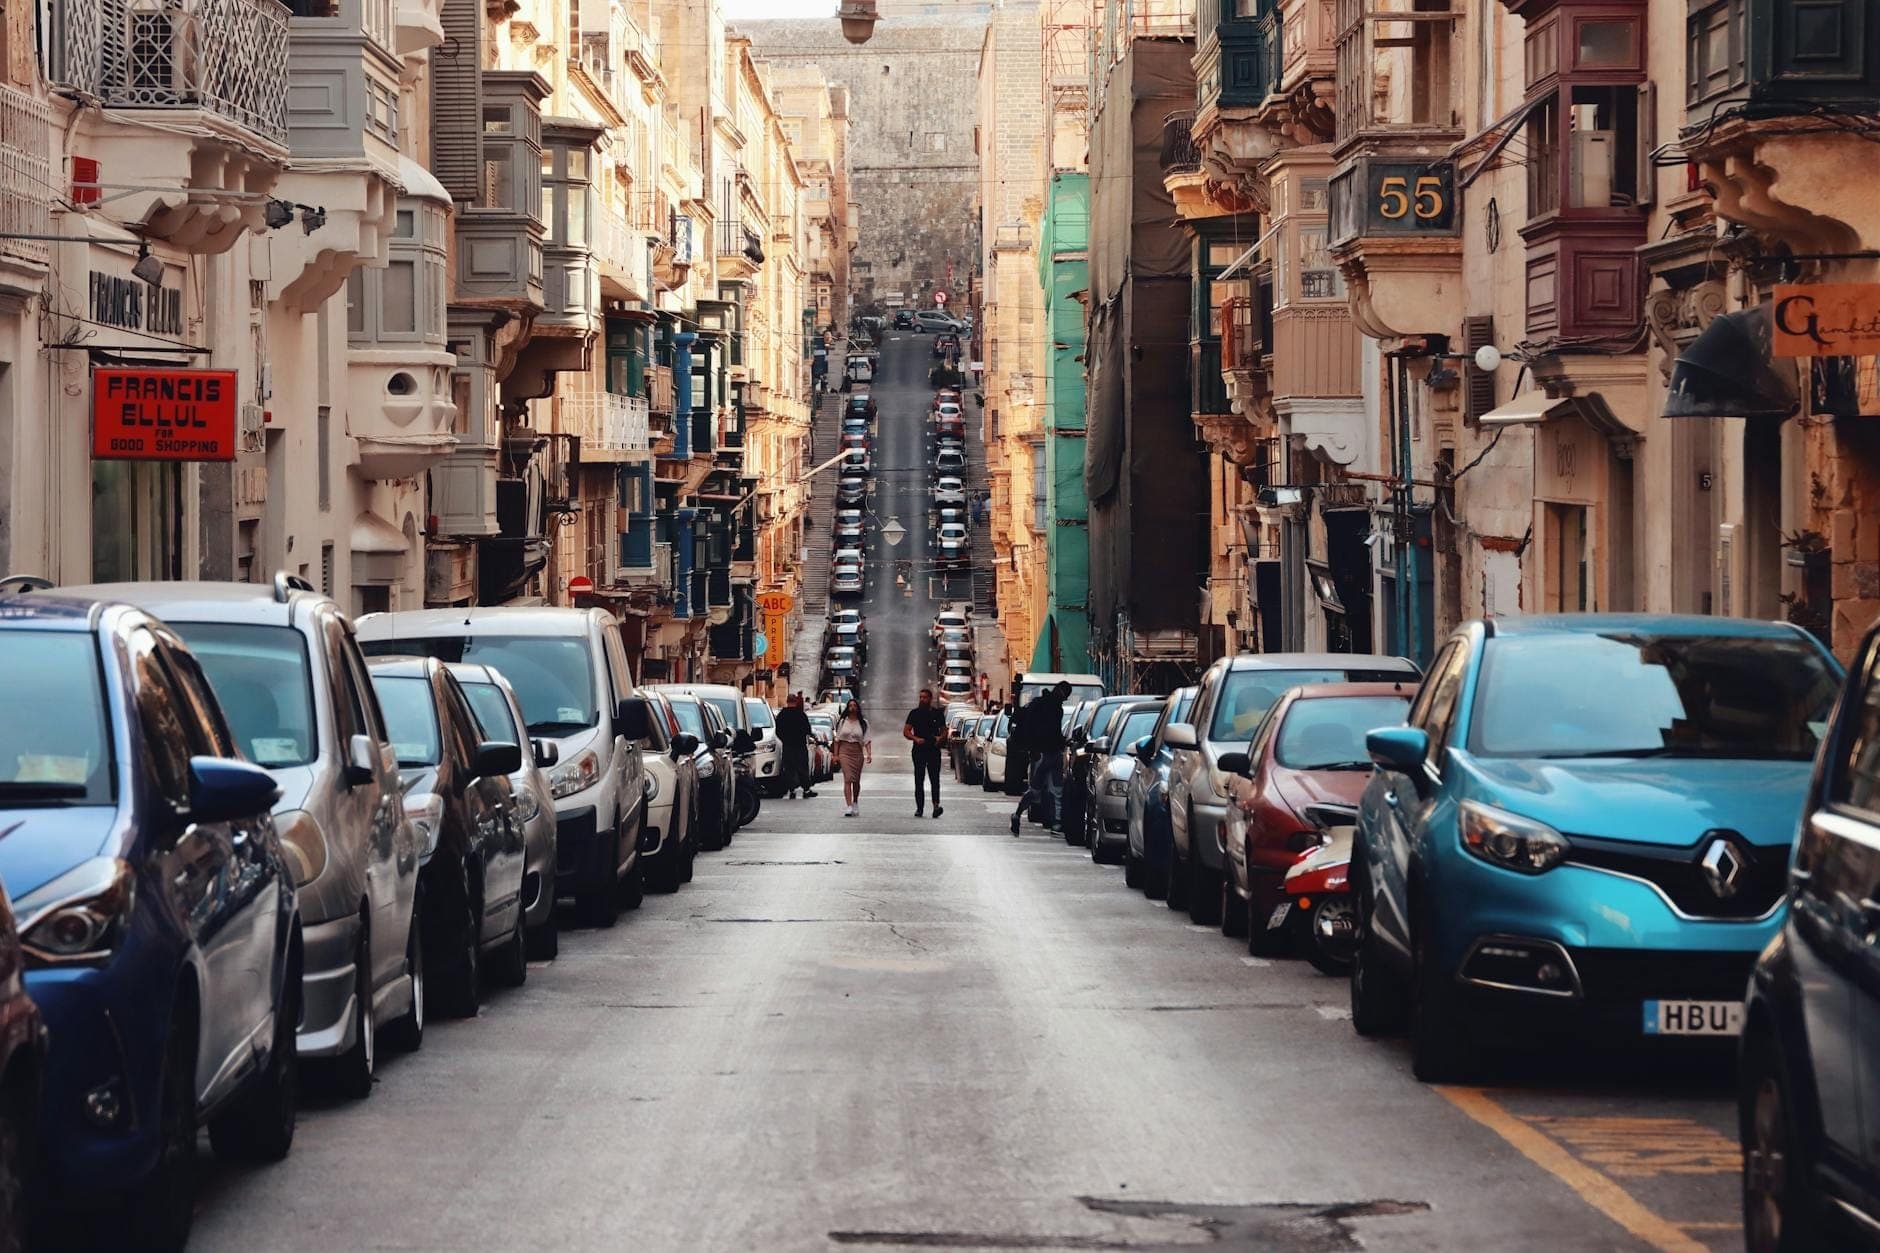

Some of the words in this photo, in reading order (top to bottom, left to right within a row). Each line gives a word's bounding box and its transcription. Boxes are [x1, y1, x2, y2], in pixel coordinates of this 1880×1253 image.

[1381, 176, 1443, 218] 55
[90, 270, 143, 329] FRANCIS
[147, 285, 182, 335] ELLUL
[108, 377, 220, 401] FRANCIS
[122, 404, 206, 427] ELLUL
[155, 429, 174, 438] FOR
[111, 439, 144, 451] GOOD
[155, 439, 217, 452] SHOPPING
[763, 598, 786, 610] ABC
